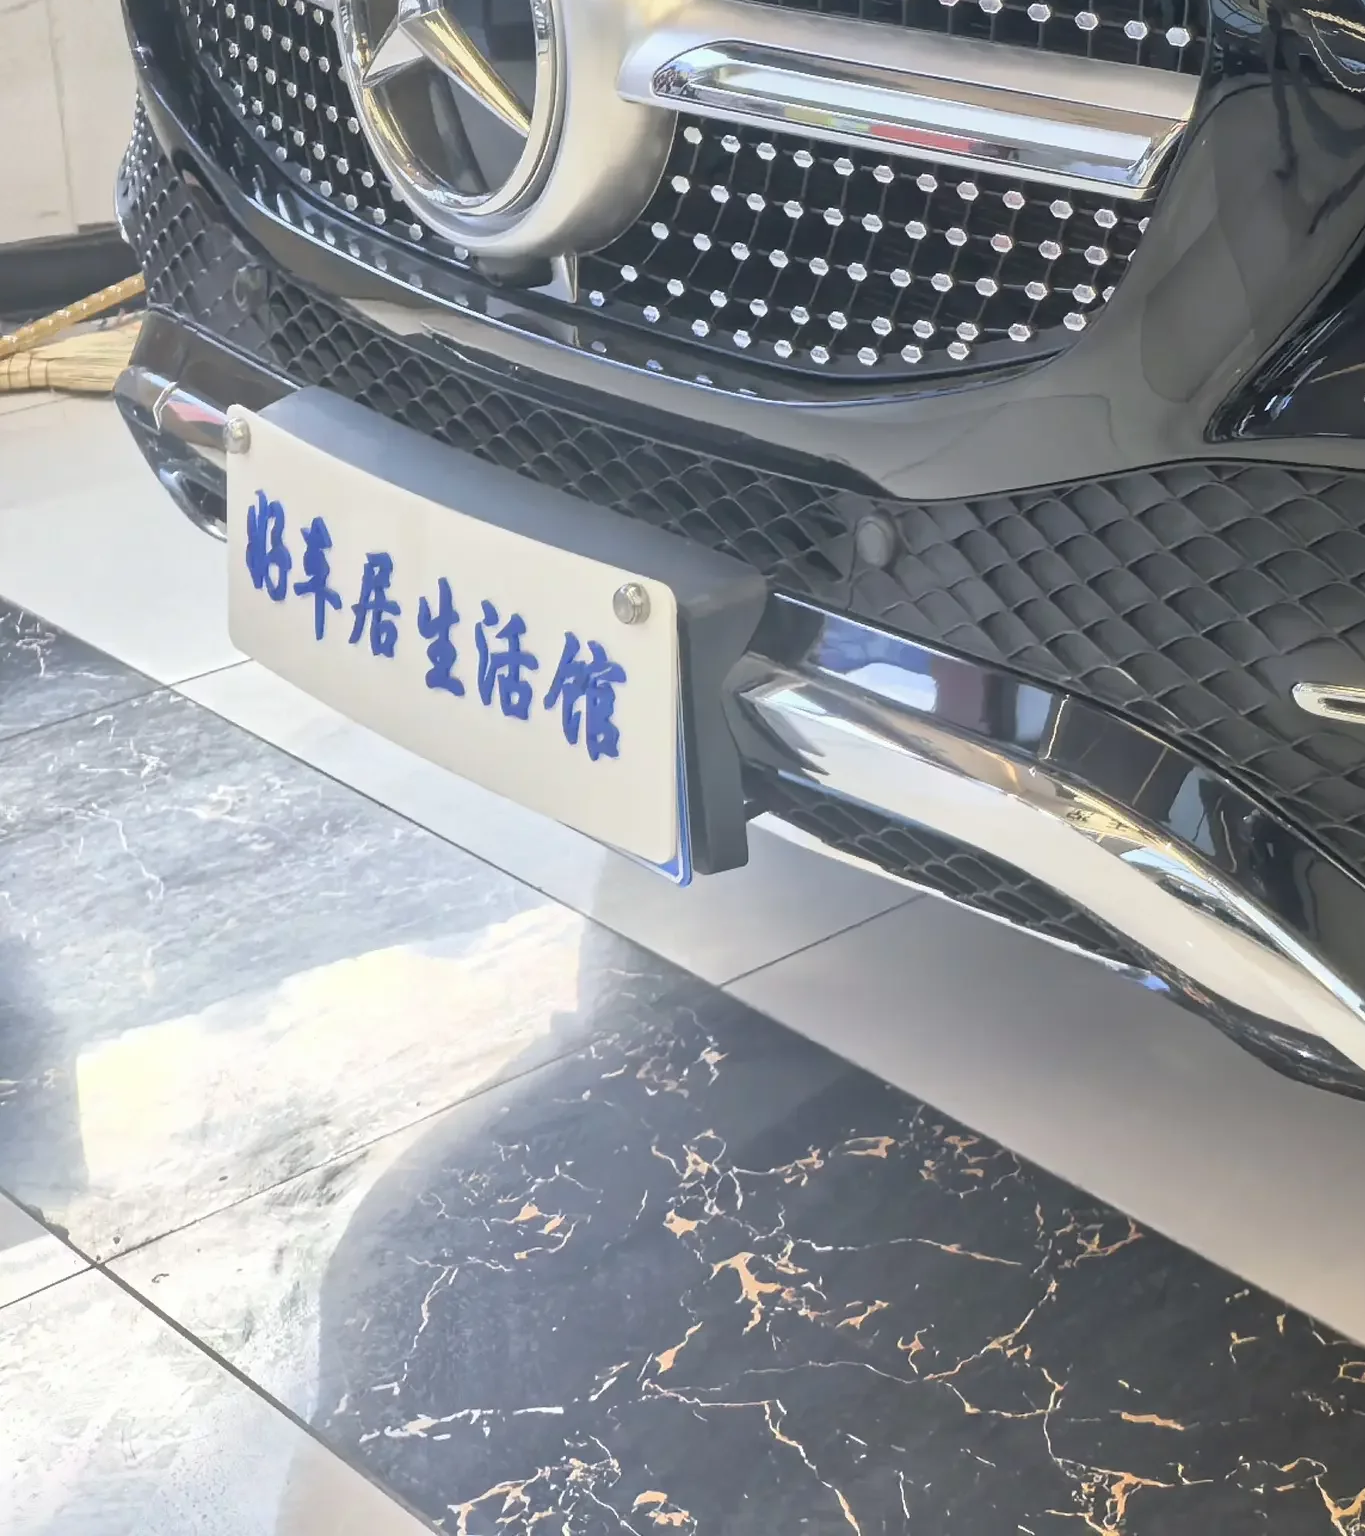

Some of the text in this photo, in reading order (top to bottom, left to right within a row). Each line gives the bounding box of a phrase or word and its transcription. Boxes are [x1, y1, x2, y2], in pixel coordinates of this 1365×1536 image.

[246, 490, 626, 762] 好车居生活馆
